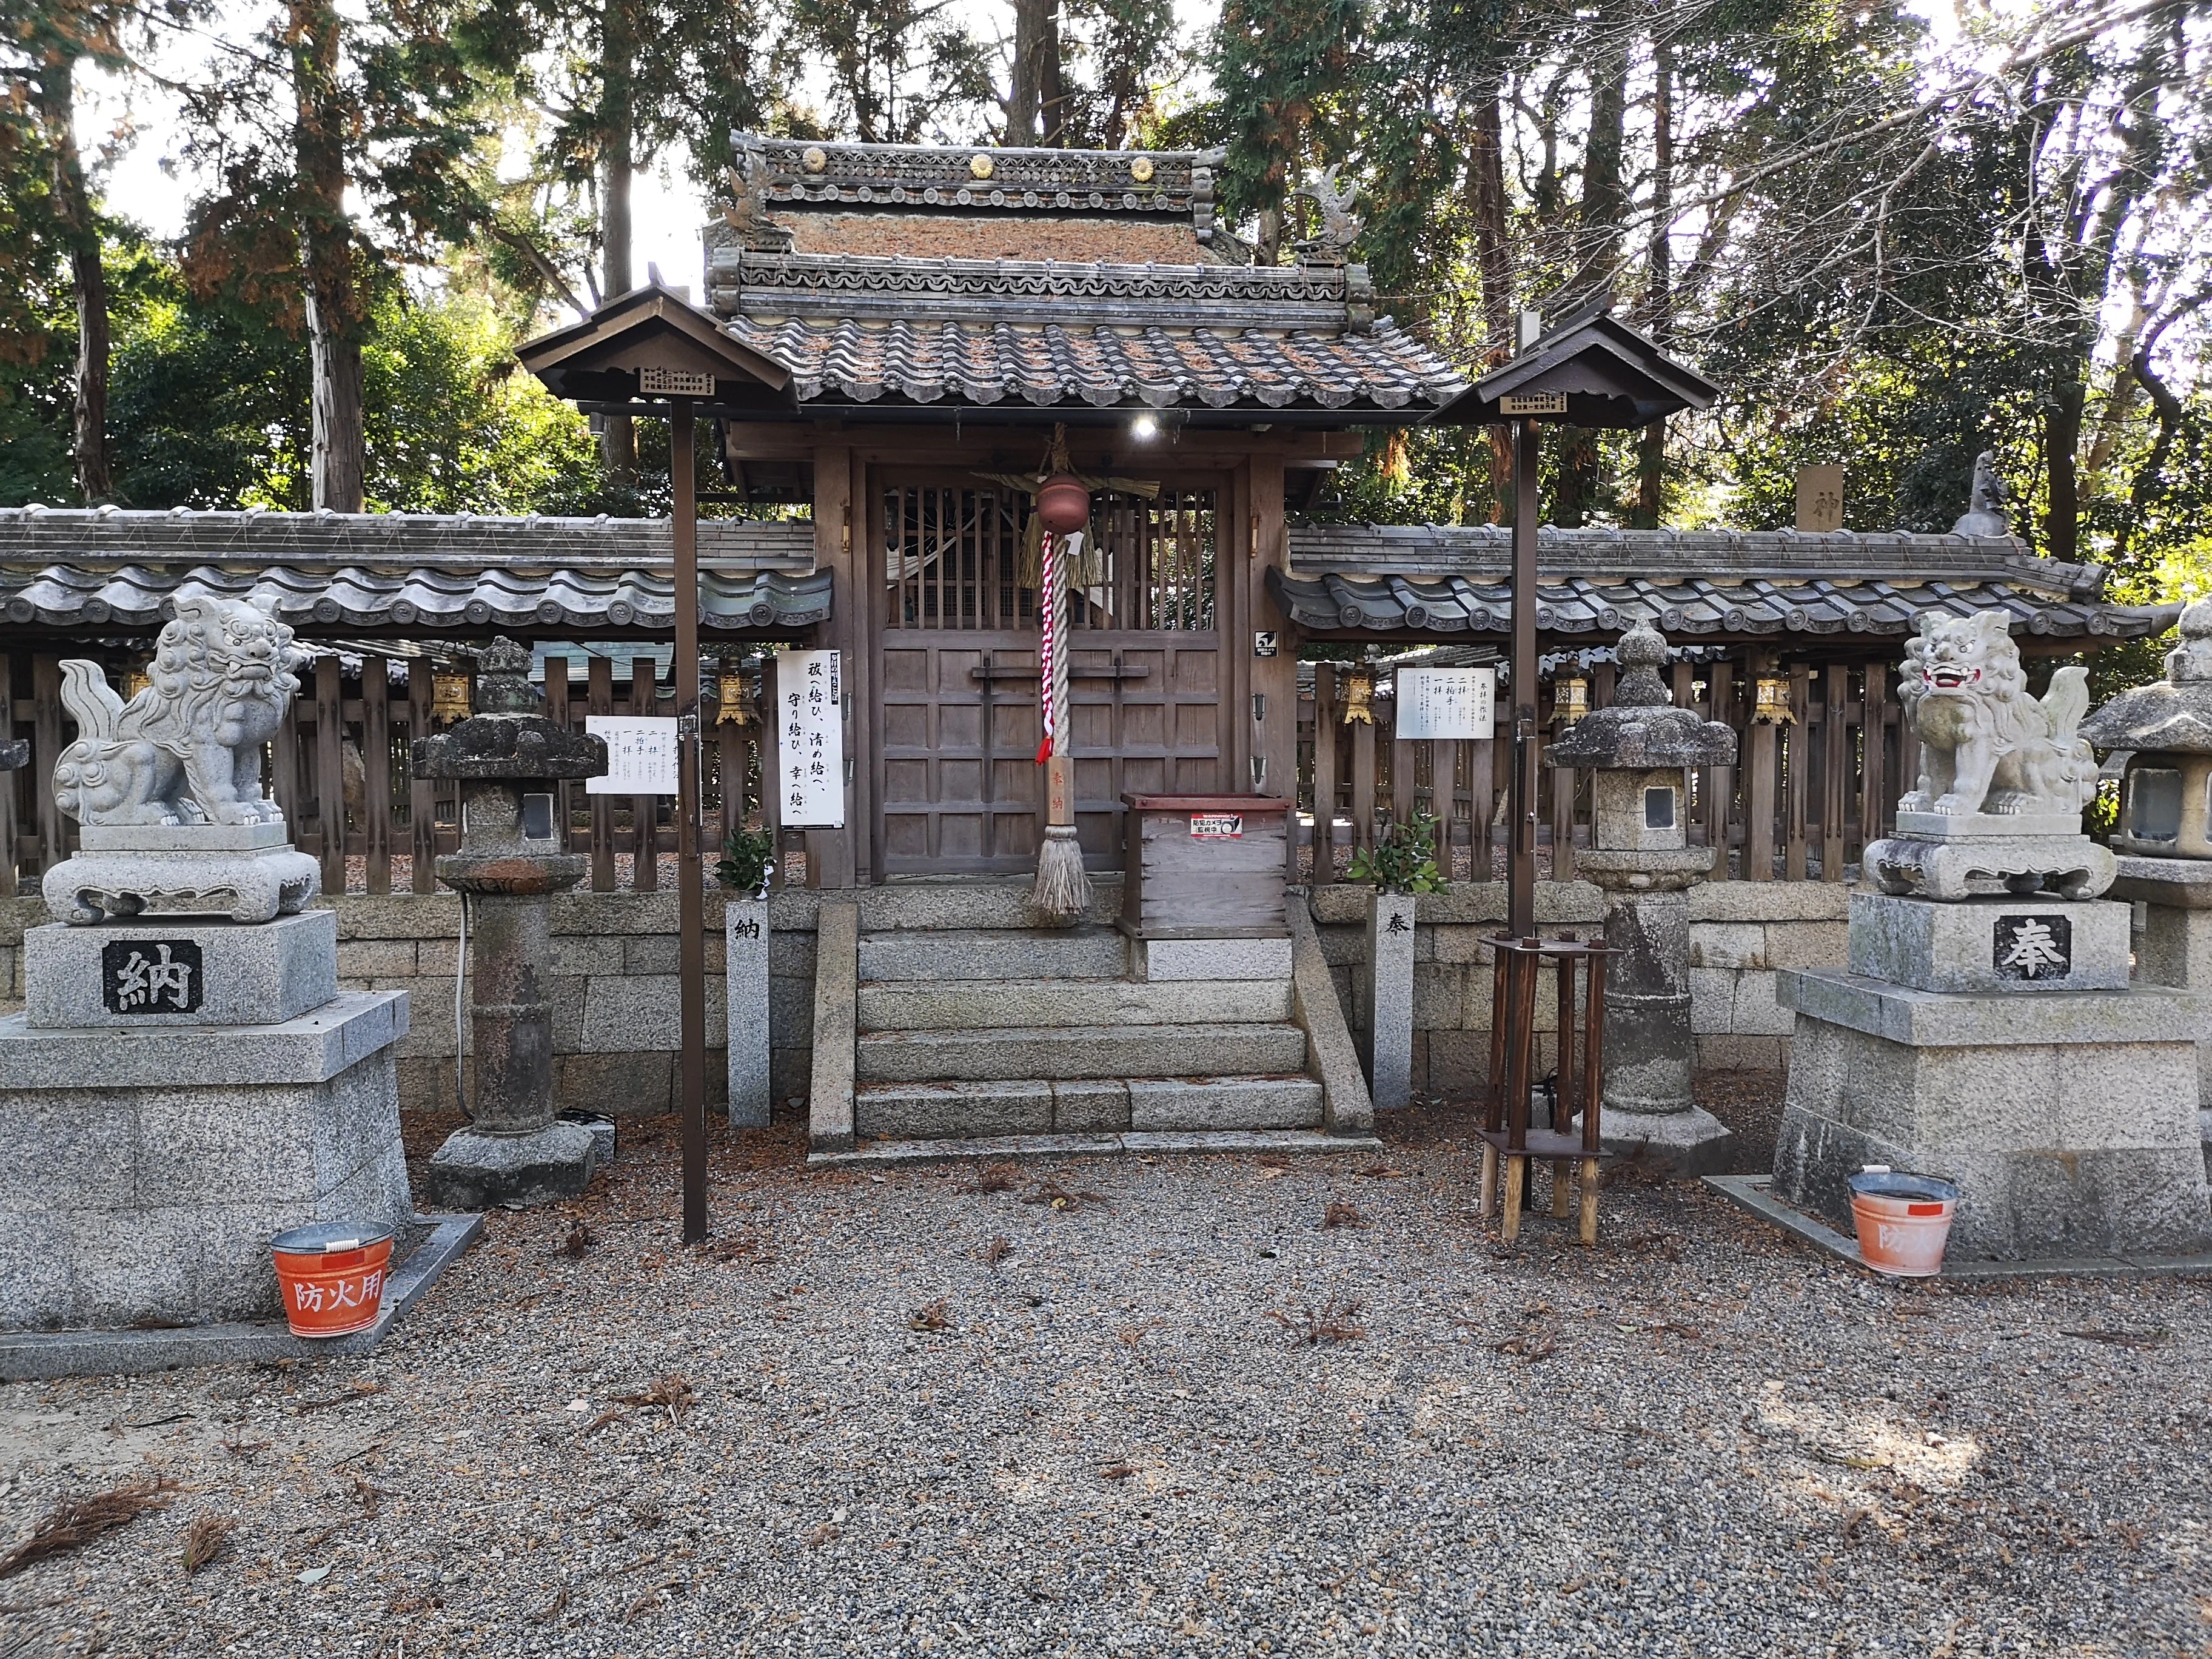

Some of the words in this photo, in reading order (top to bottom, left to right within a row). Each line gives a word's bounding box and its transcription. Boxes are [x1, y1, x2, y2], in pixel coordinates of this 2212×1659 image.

[1433, 678, 1443, 695] 一拝
[1446, 677, 1455, 705] 二拍手
[1458, 677, 1467, 695] 二拝
[1479, 683, 1488, 722] 参拝の作法
[635, 730, 645, 755] 二拍手
[1052, 771, 1063, 809] 奉納
[734, 918, 760, 940] 納
[1385, 912, 1410, 936] 奉
[2001, 918, 2068, 977] 奉
[117, 943, 192, 1011] 納
[293, 1269, 382, 1312] 防火用
